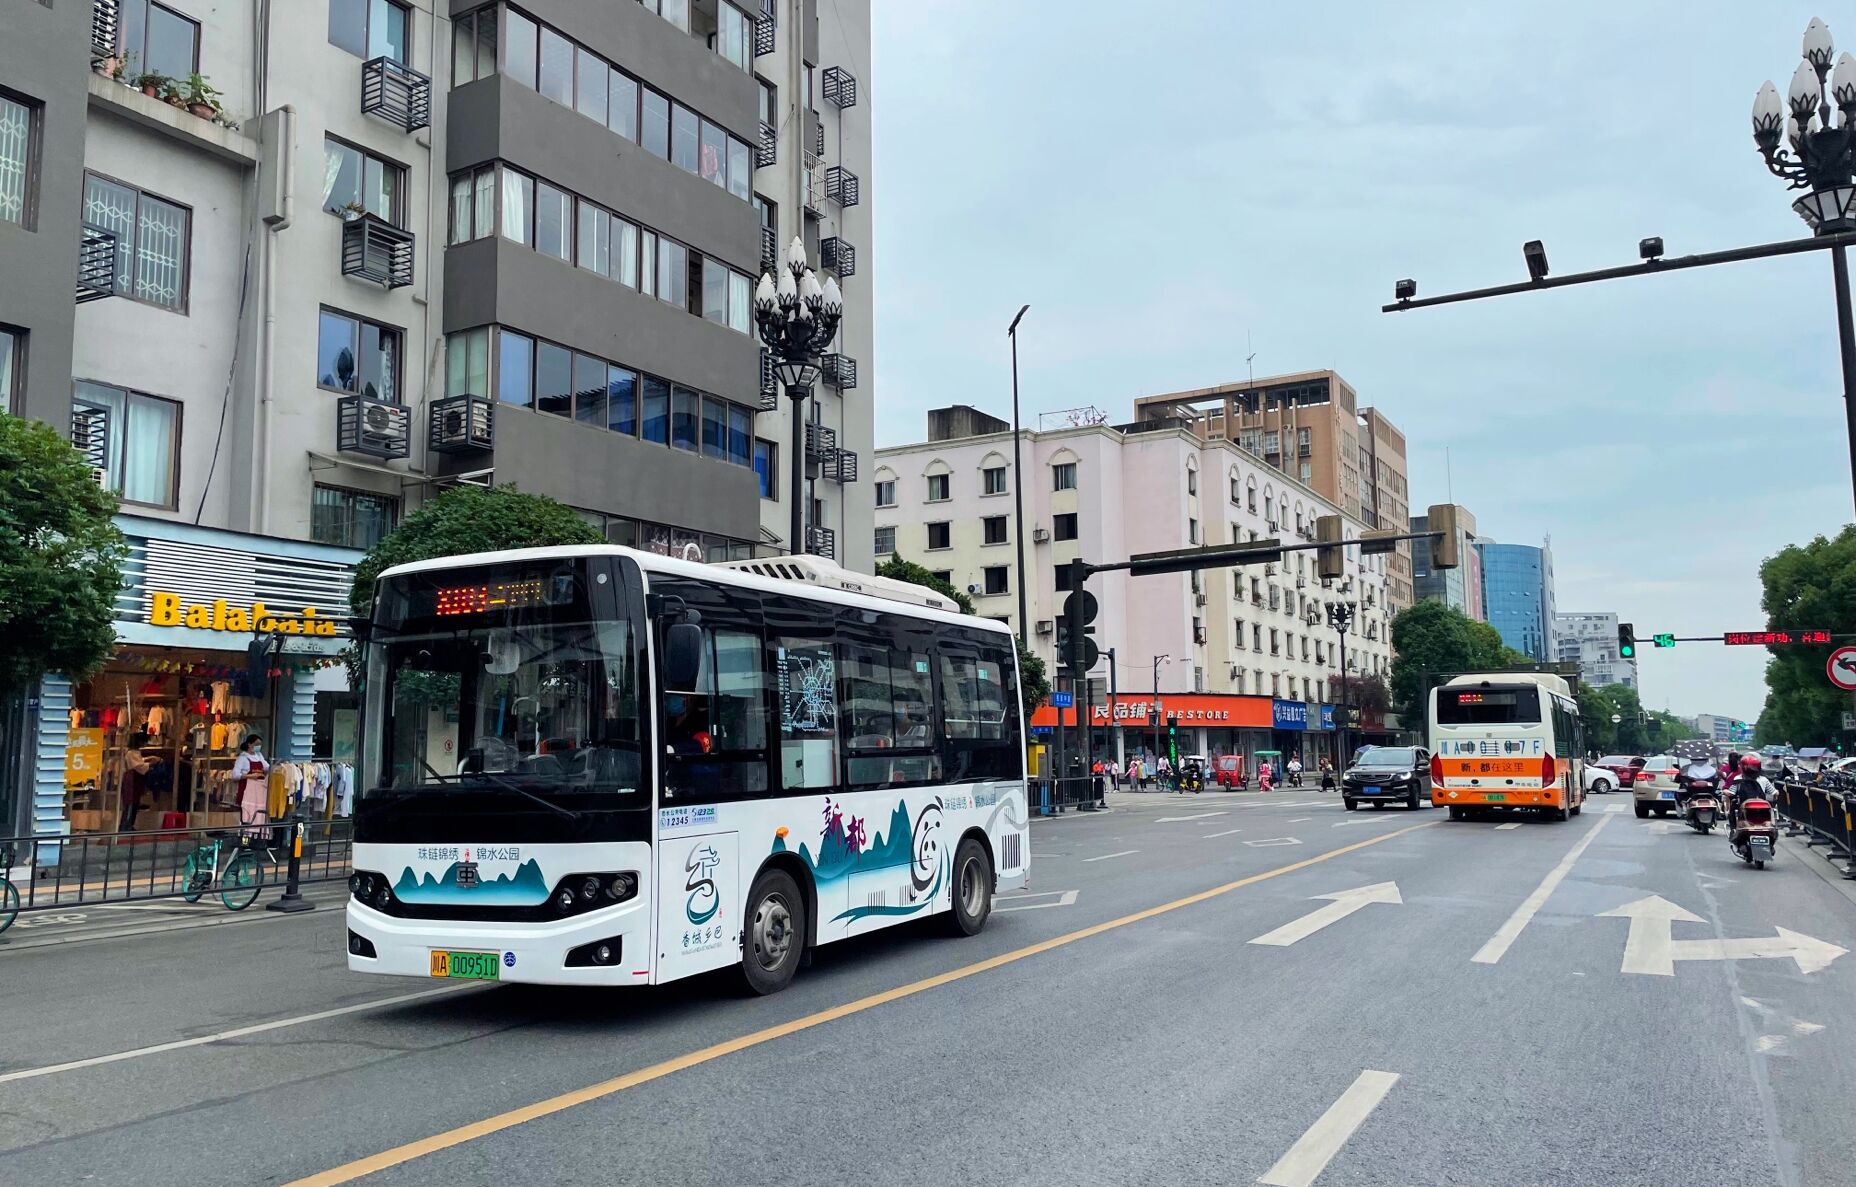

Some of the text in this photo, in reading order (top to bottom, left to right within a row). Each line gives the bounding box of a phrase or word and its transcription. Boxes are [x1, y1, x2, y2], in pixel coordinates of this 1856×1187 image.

[150, 591, 337, 636] Balabala
[666, 815, 689, 827] 12345
[418, 847, 460, 861] 珠链锦绣
[477, 847, 520, 861] 锦水公园
